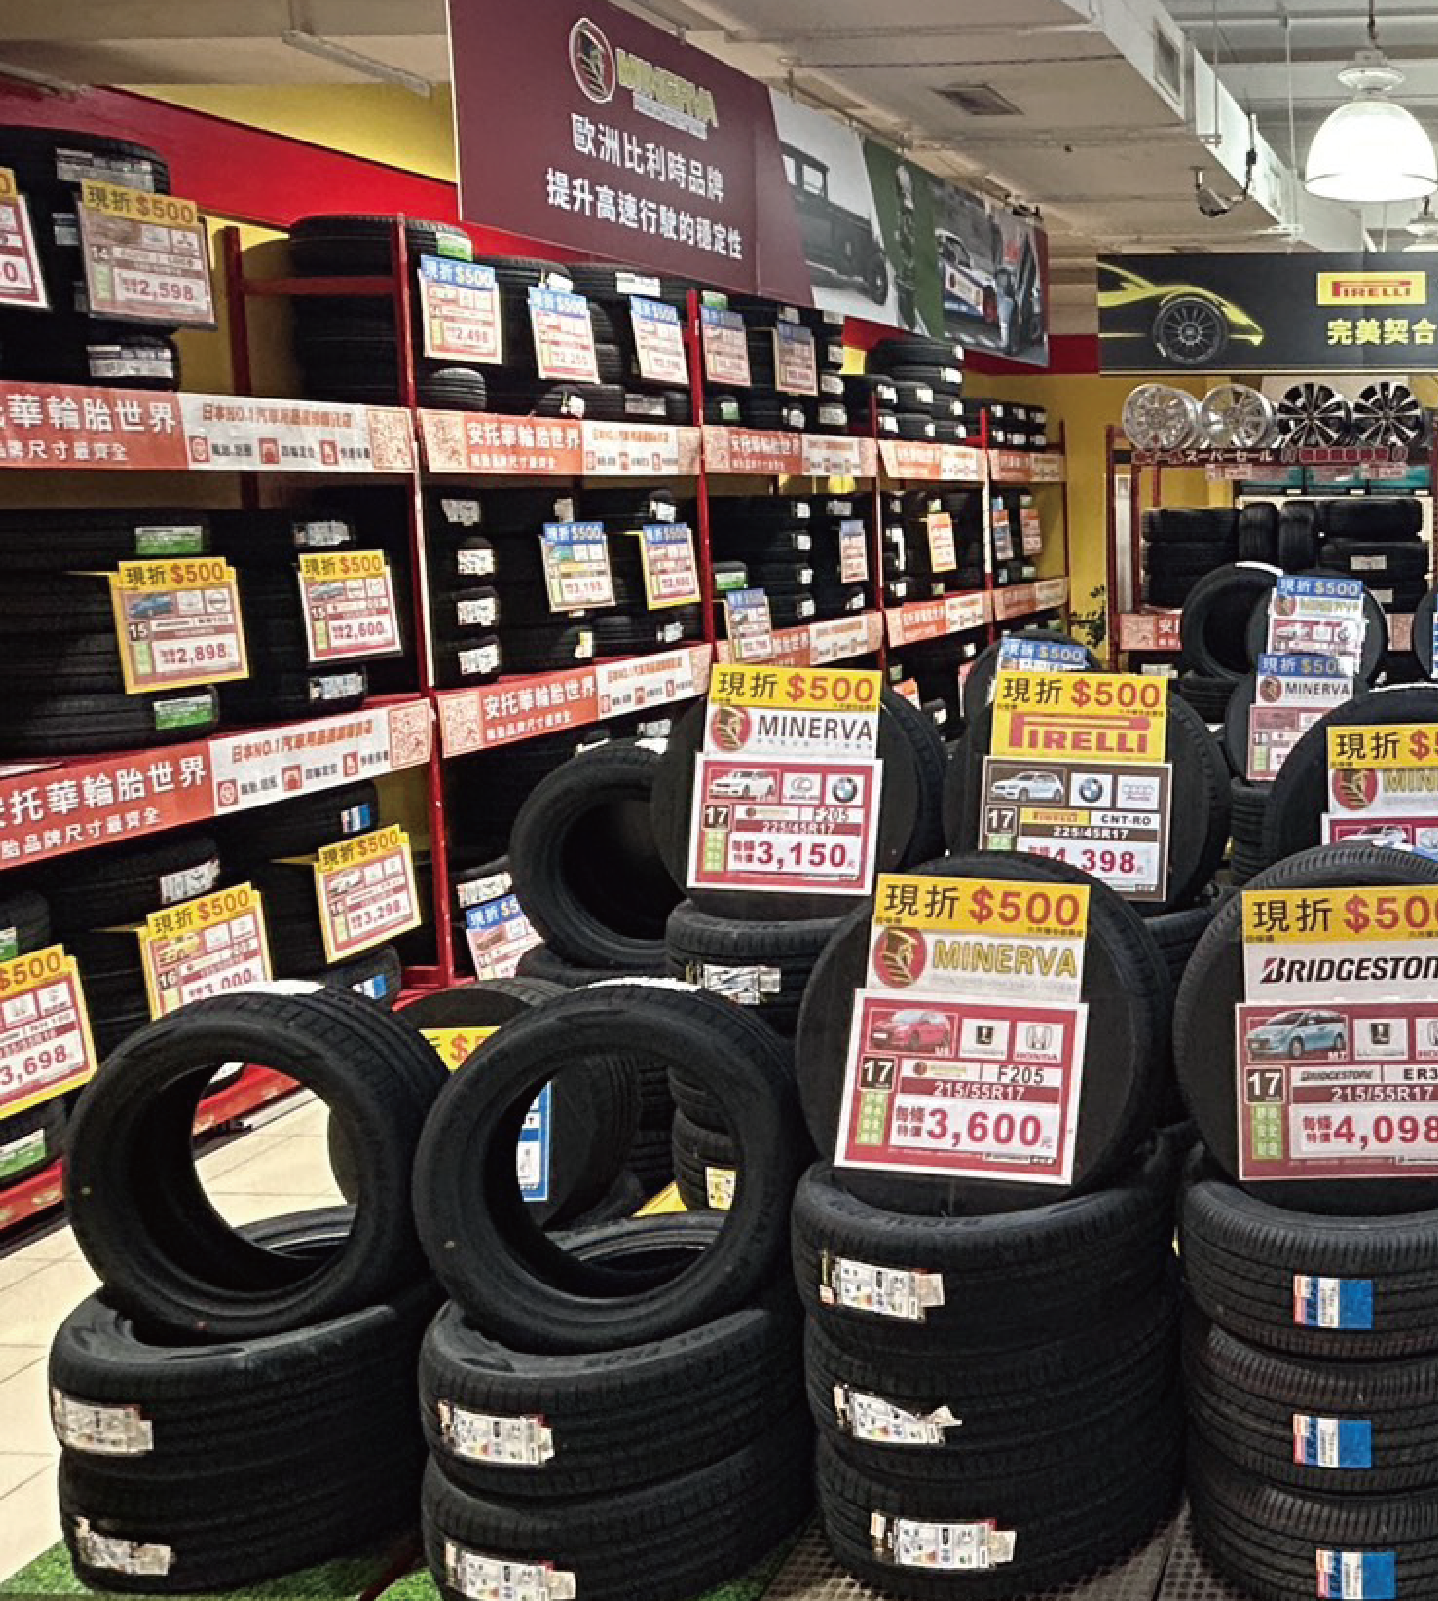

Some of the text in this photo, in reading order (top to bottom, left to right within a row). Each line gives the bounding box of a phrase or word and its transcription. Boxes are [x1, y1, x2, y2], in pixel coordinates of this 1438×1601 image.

[571, 112, 723, 203] 歐洲比利時品牌
[87, 186, 193, 223] 現折 $500
[546, 168, 742, 259] 提升高速行駛的穩定性
[1332, 280, 1412, 297] PIRELLI
[1327, 318, 1437, 345] 完美契合
[0, 394, 175, 434] 華輪胎世界
[0, 439, 128, 461] 牌尺寸最齊全
[126, 562, 224, 588] 現折 $500
[304, 550, 384, 575] 現折 $500
[1280, 579, 1360, 596] 現折 $500
[177, 644, 226, 665] 2,898
[1262, 657, 1296, 673] 現折
[719, 672, 874, 703] 現折 $500
[1003, 678, 1161, 708] 現折 $500
[1284, 681, 1350, 696] MINERVA
[758, 714, 873, 741] MINERVA
[1009, 711, 1151, 754] PIRELLI
[1335, 731, 1400, 761] 現折
[705, 805, 729, 829] 17
[988, 809, 1013, 829] 17
[322, 832, 399, 868] 現折 $500
[154, 889, 250, 935] 現折 $500
[500, 899, 518, 918] $5
[884, 883, 1080, 926] 現折 $500
[1252, 898, 1333, 932] 現折
[933, 939, 1078, 978] MINERVA
[1, 1044, 68, 1085] 3,698
[863, 1061, 892, 1081] 17
[998, 1065, 1045, 1084] F205
[934, 1082, 1025, 1100] 215/55R17
[1249, 1072, 1282, 1096] 17
[1332, 1087, 1434, 1100] 215/55R17
